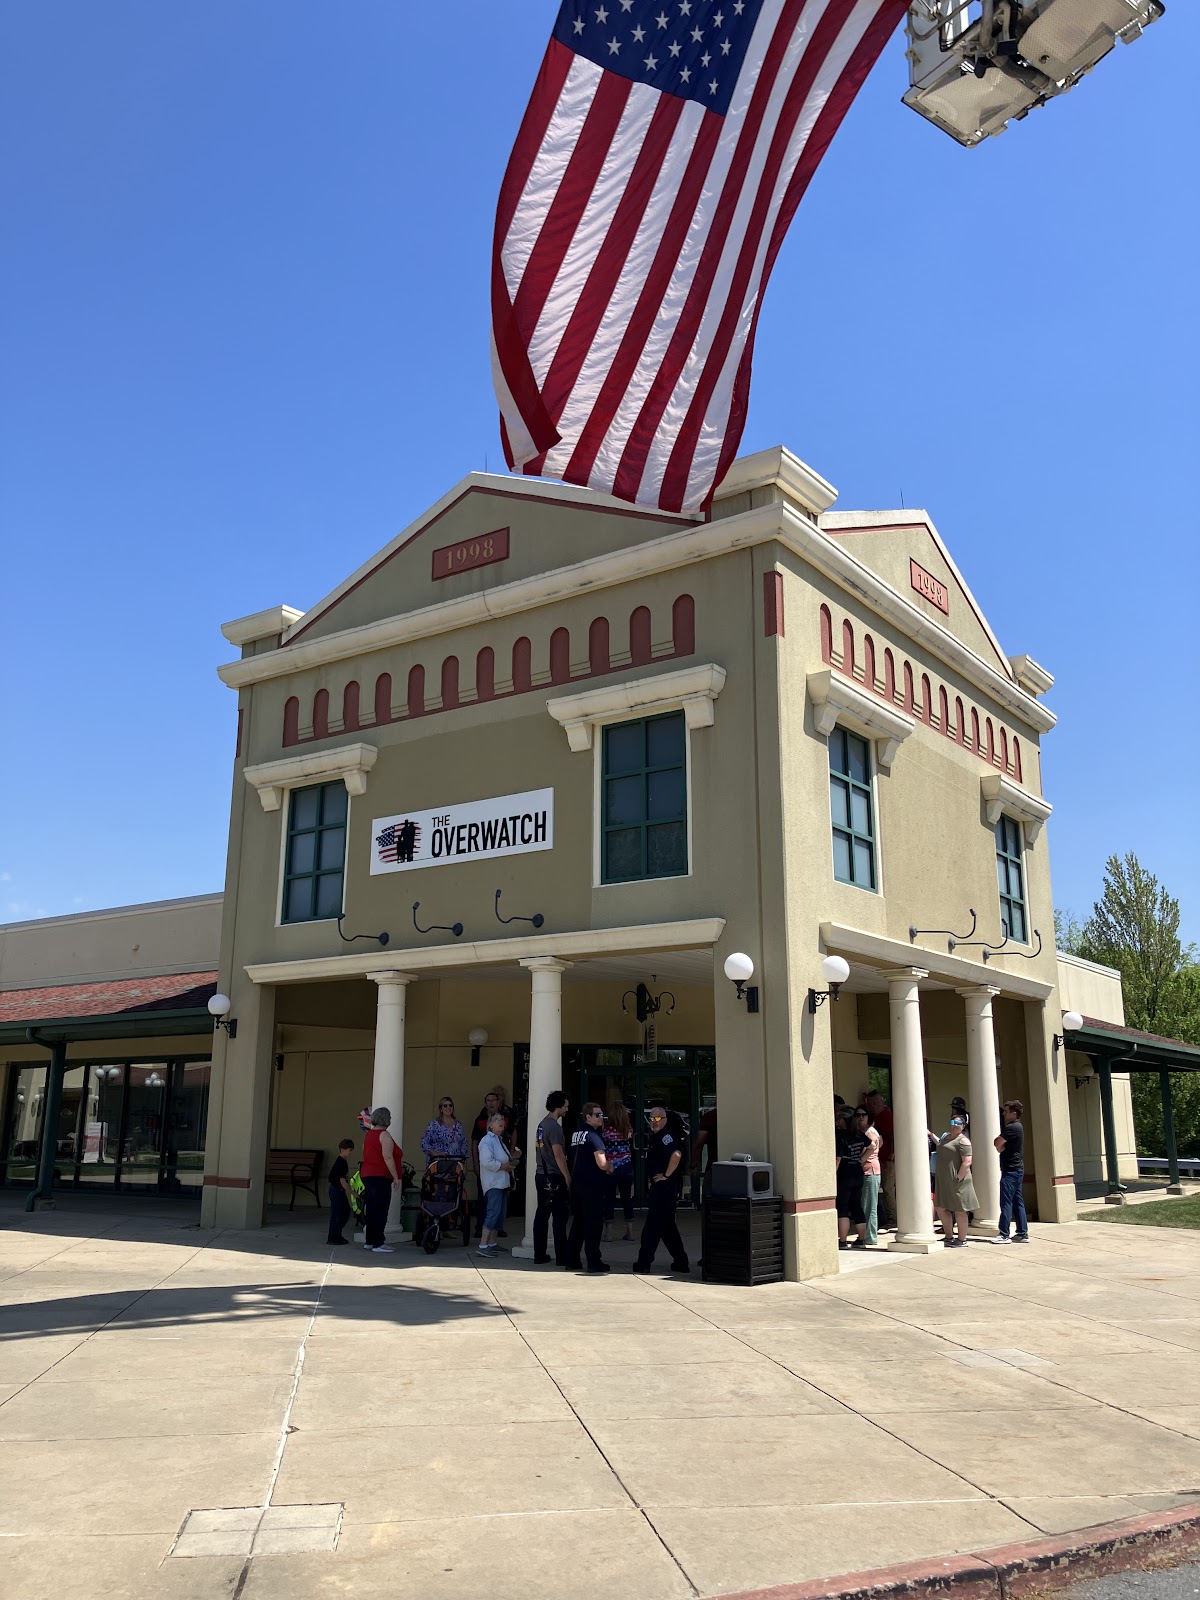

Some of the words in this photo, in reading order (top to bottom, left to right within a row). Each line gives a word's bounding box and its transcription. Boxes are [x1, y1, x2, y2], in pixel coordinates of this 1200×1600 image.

[447, 538, 494, 571] 1998
[917, 571, 943, 606] 1998
[431, 814, 451, 828] THE
[431, 810, 547, 858] OVERWATCH
